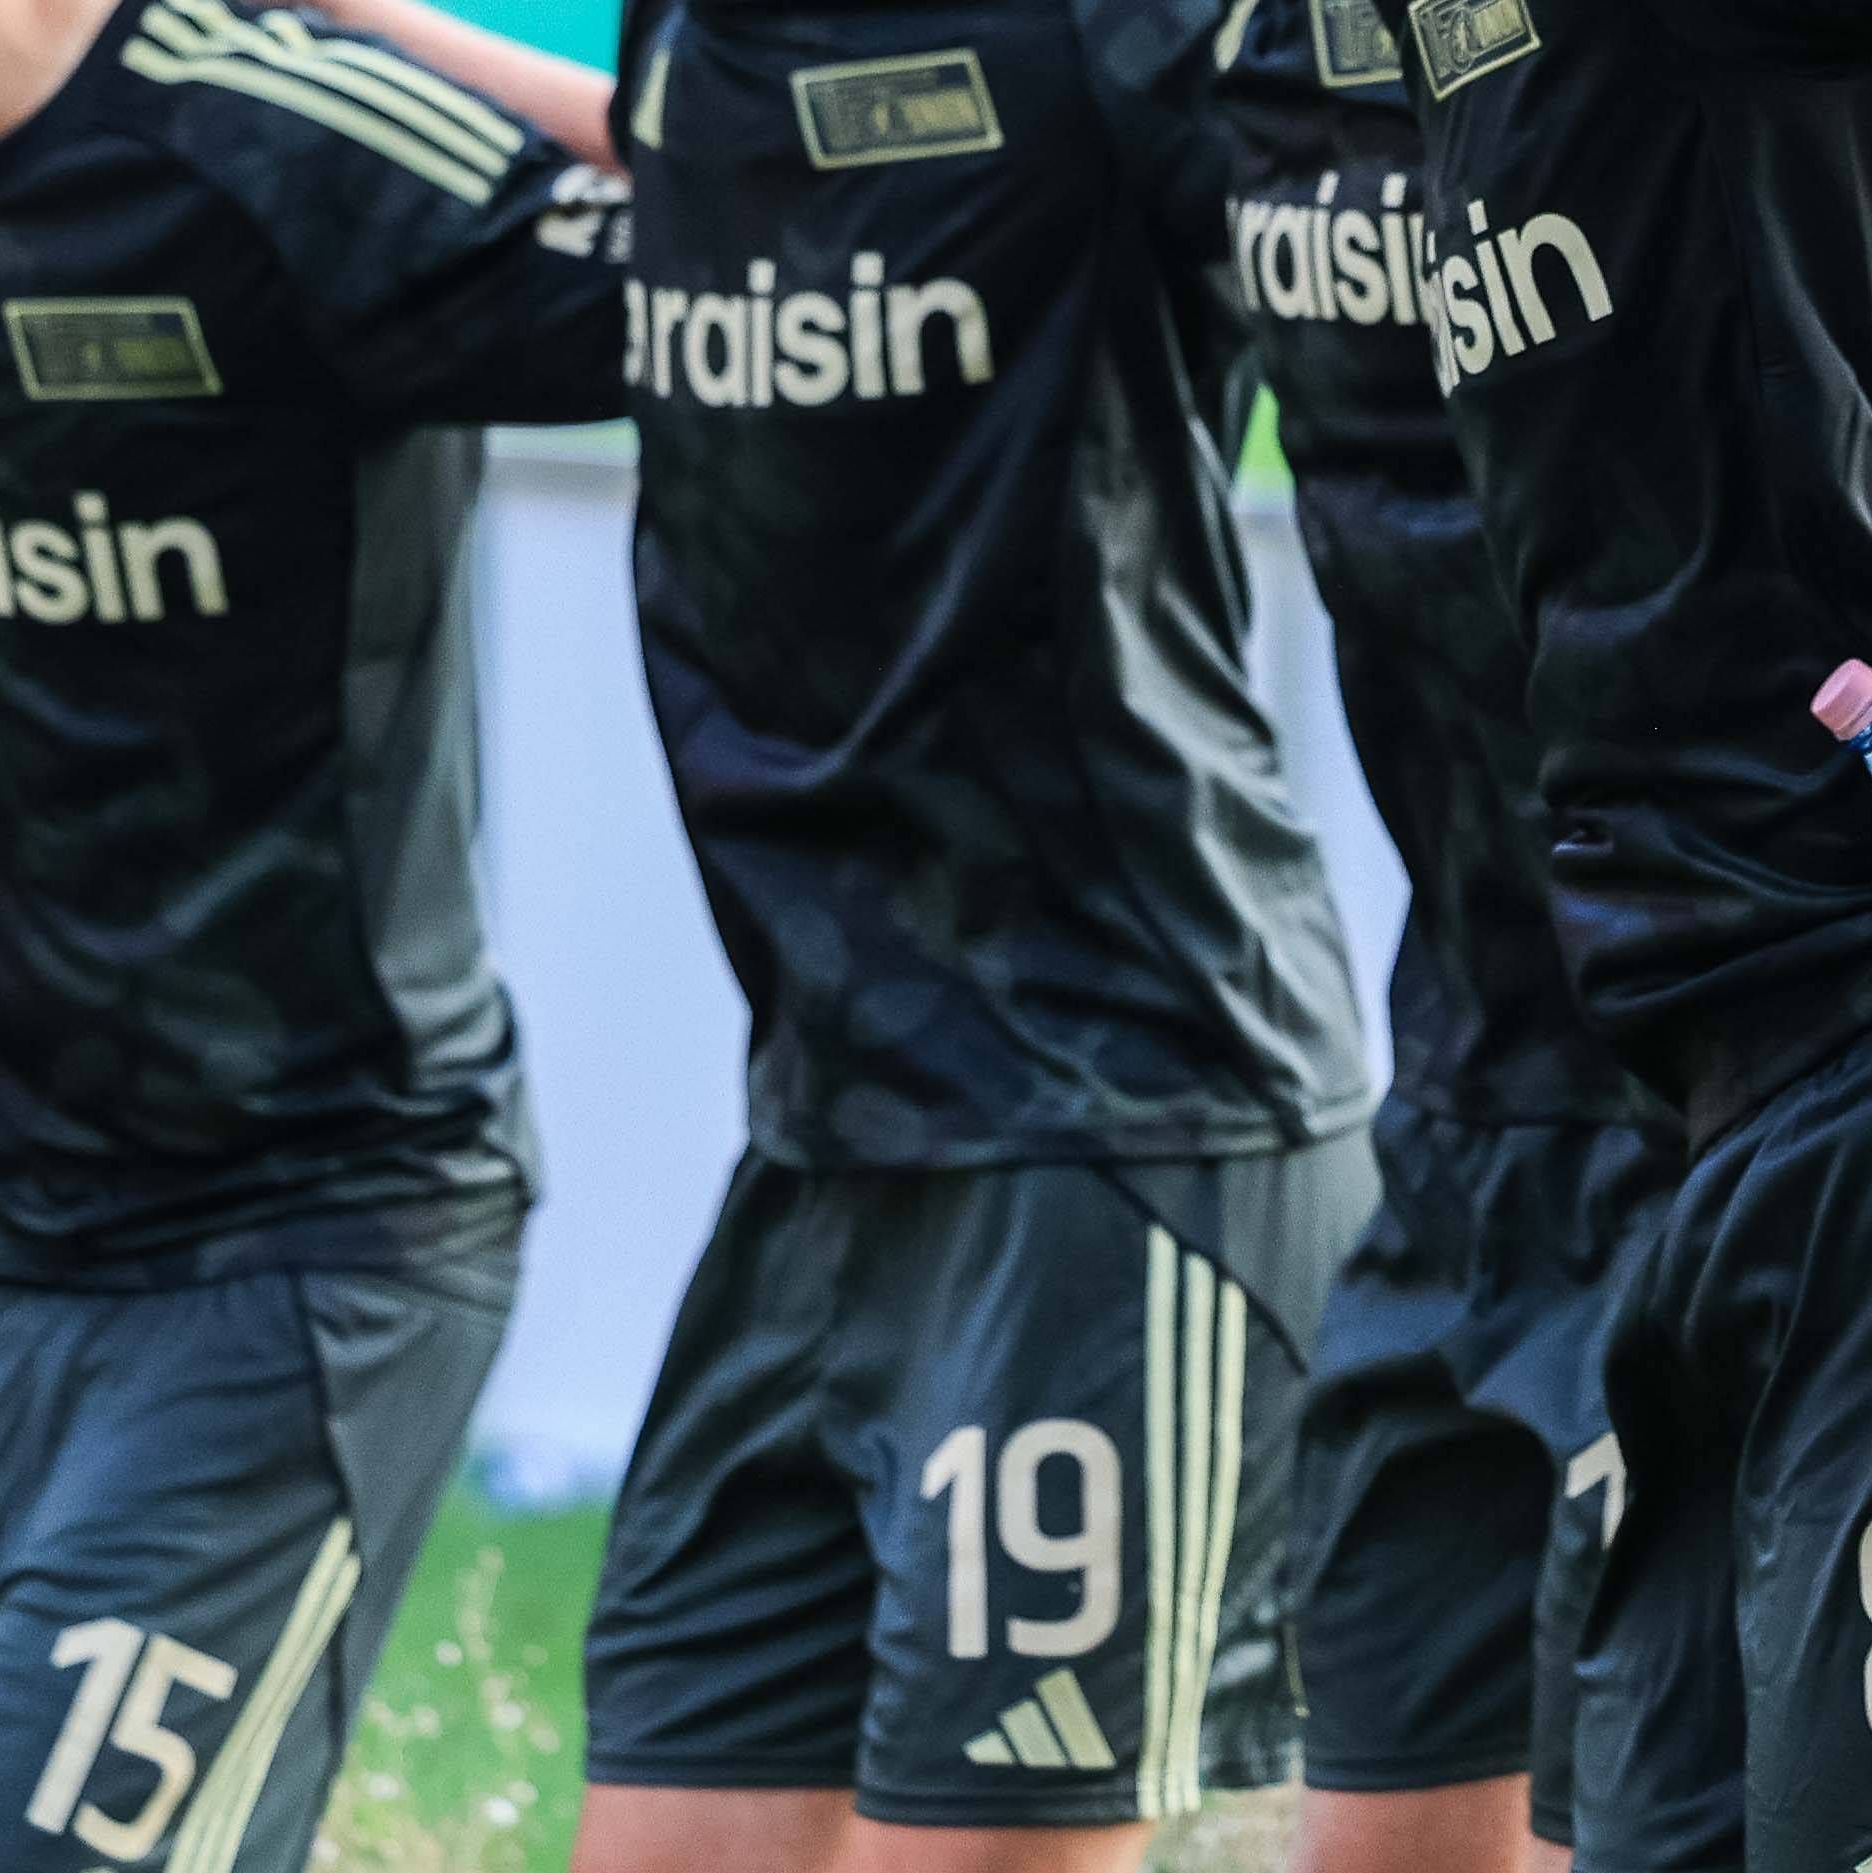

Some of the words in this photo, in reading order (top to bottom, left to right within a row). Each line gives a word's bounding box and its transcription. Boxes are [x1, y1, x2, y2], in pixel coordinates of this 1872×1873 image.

[651, 249, 994, 409] raisin
[1237, 170, 1428, 325] raisi
[920, 1417, 1124, 1659] 19
[24, 1616, 239, 1859] 15
